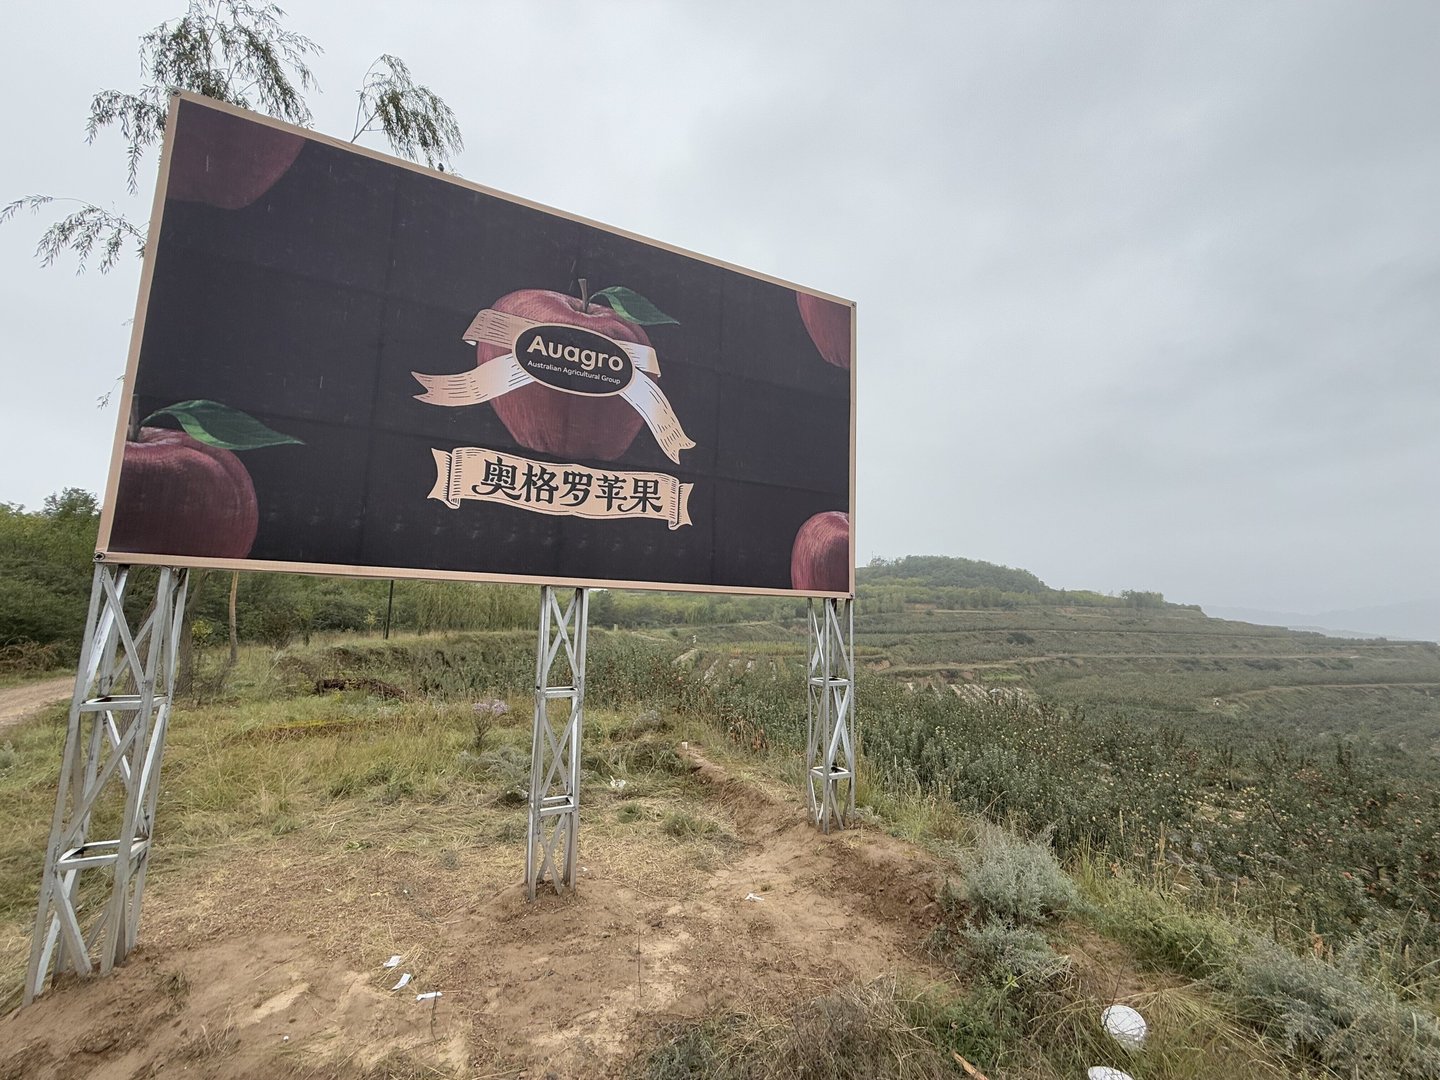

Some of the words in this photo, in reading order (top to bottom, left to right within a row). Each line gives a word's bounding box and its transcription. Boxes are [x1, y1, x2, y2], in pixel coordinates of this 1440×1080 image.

[526, 335, 624, 372] Auagro
[527, 360, 562, 373] Australian
[562, 366, 601, 381] Agricultural
[601, 374, 621, 386] Group
[471, 456, 664, 514] 奥格罗苹果
